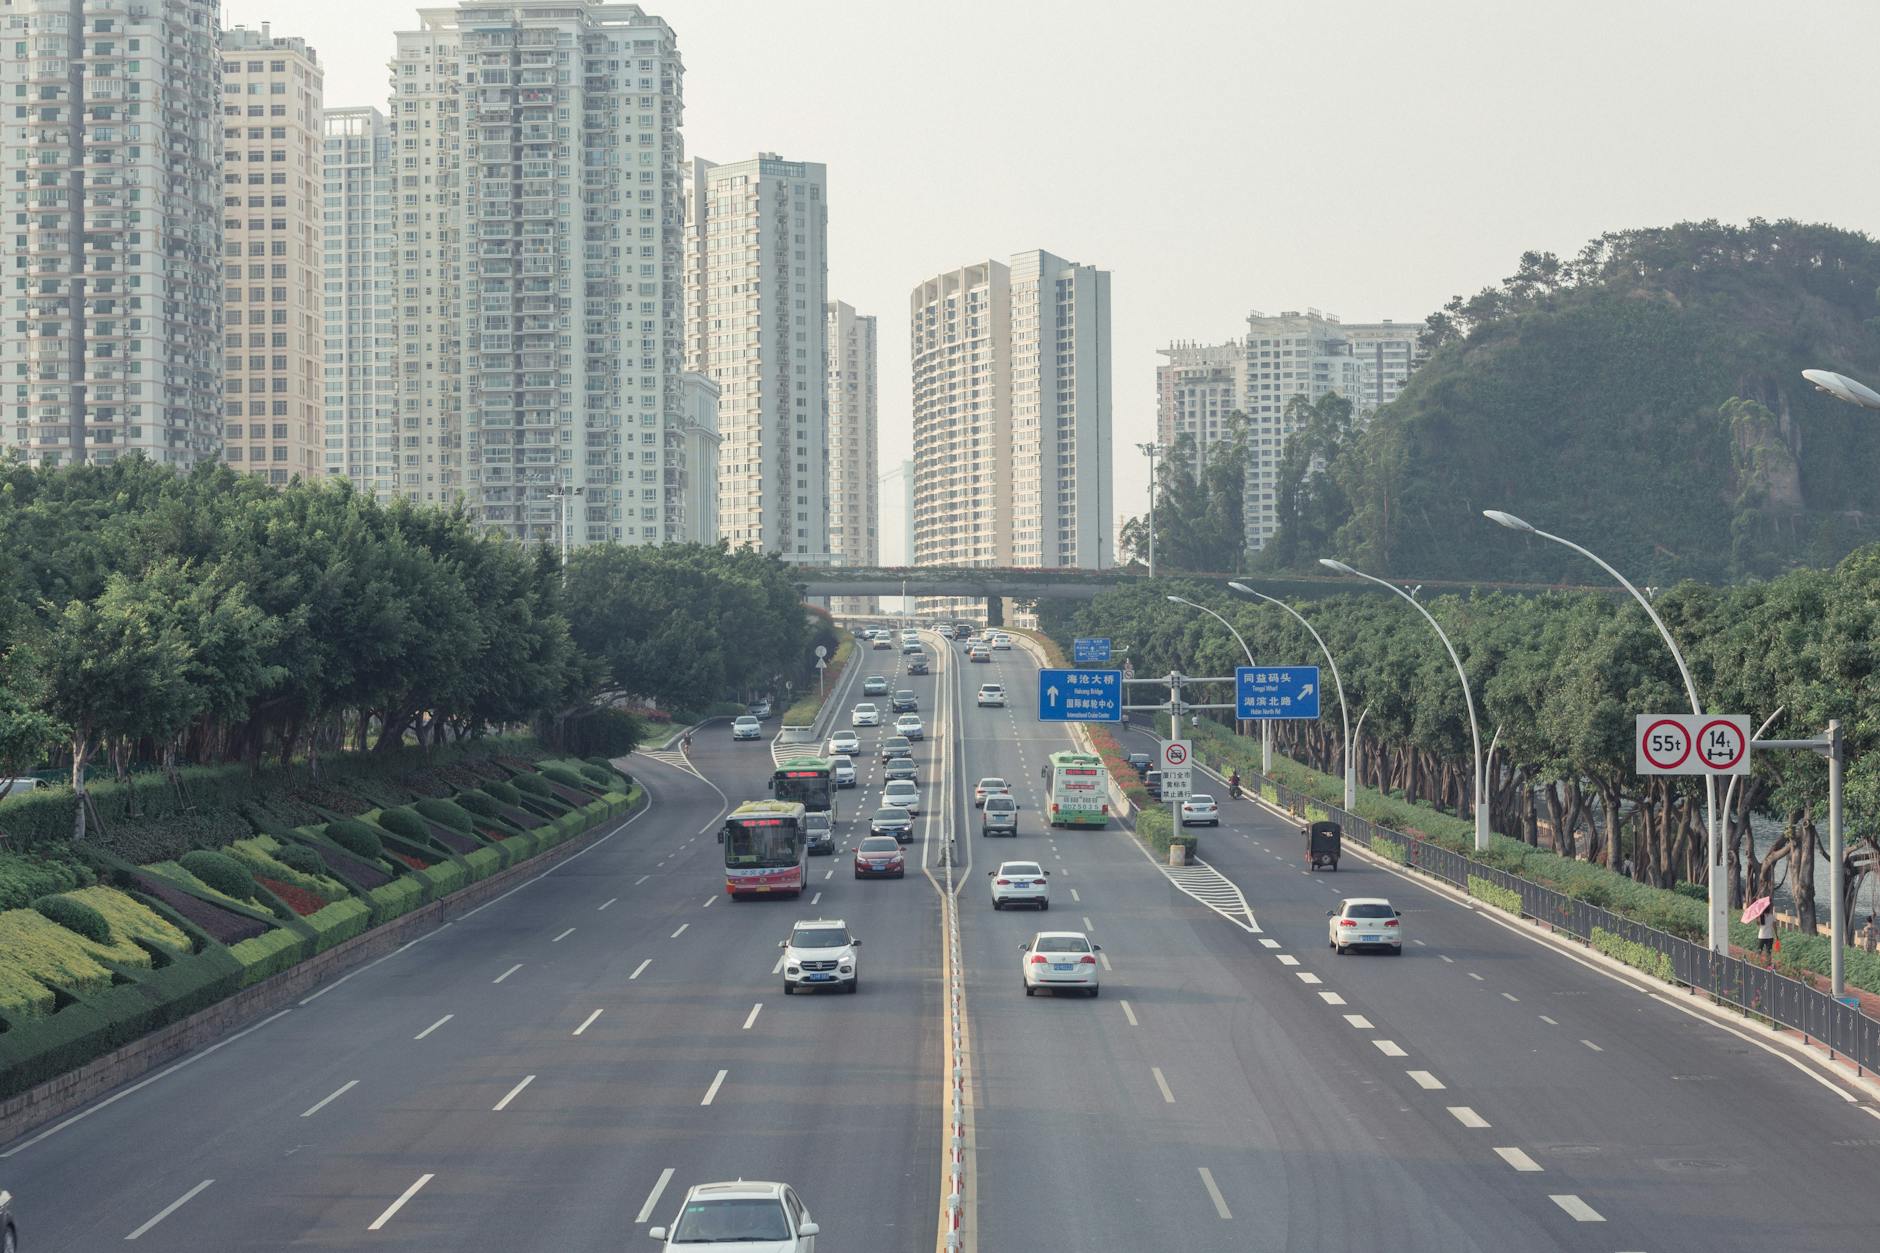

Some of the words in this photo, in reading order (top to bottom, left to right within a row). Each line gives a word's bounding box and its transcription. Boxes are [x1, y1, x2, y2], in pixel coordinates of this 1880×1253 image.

[1066, 674, 1115, 685] 海沧大桥
[1243, 673, 1291, 684] 同益码头
[1066, 698, 1114, 709] 国际邮轮中心
[1244, 696, 1291, 706] 湖滨北路
[1652, 735, 1681, 752] 55t
[1709, 730, 1730, 748] 14t
